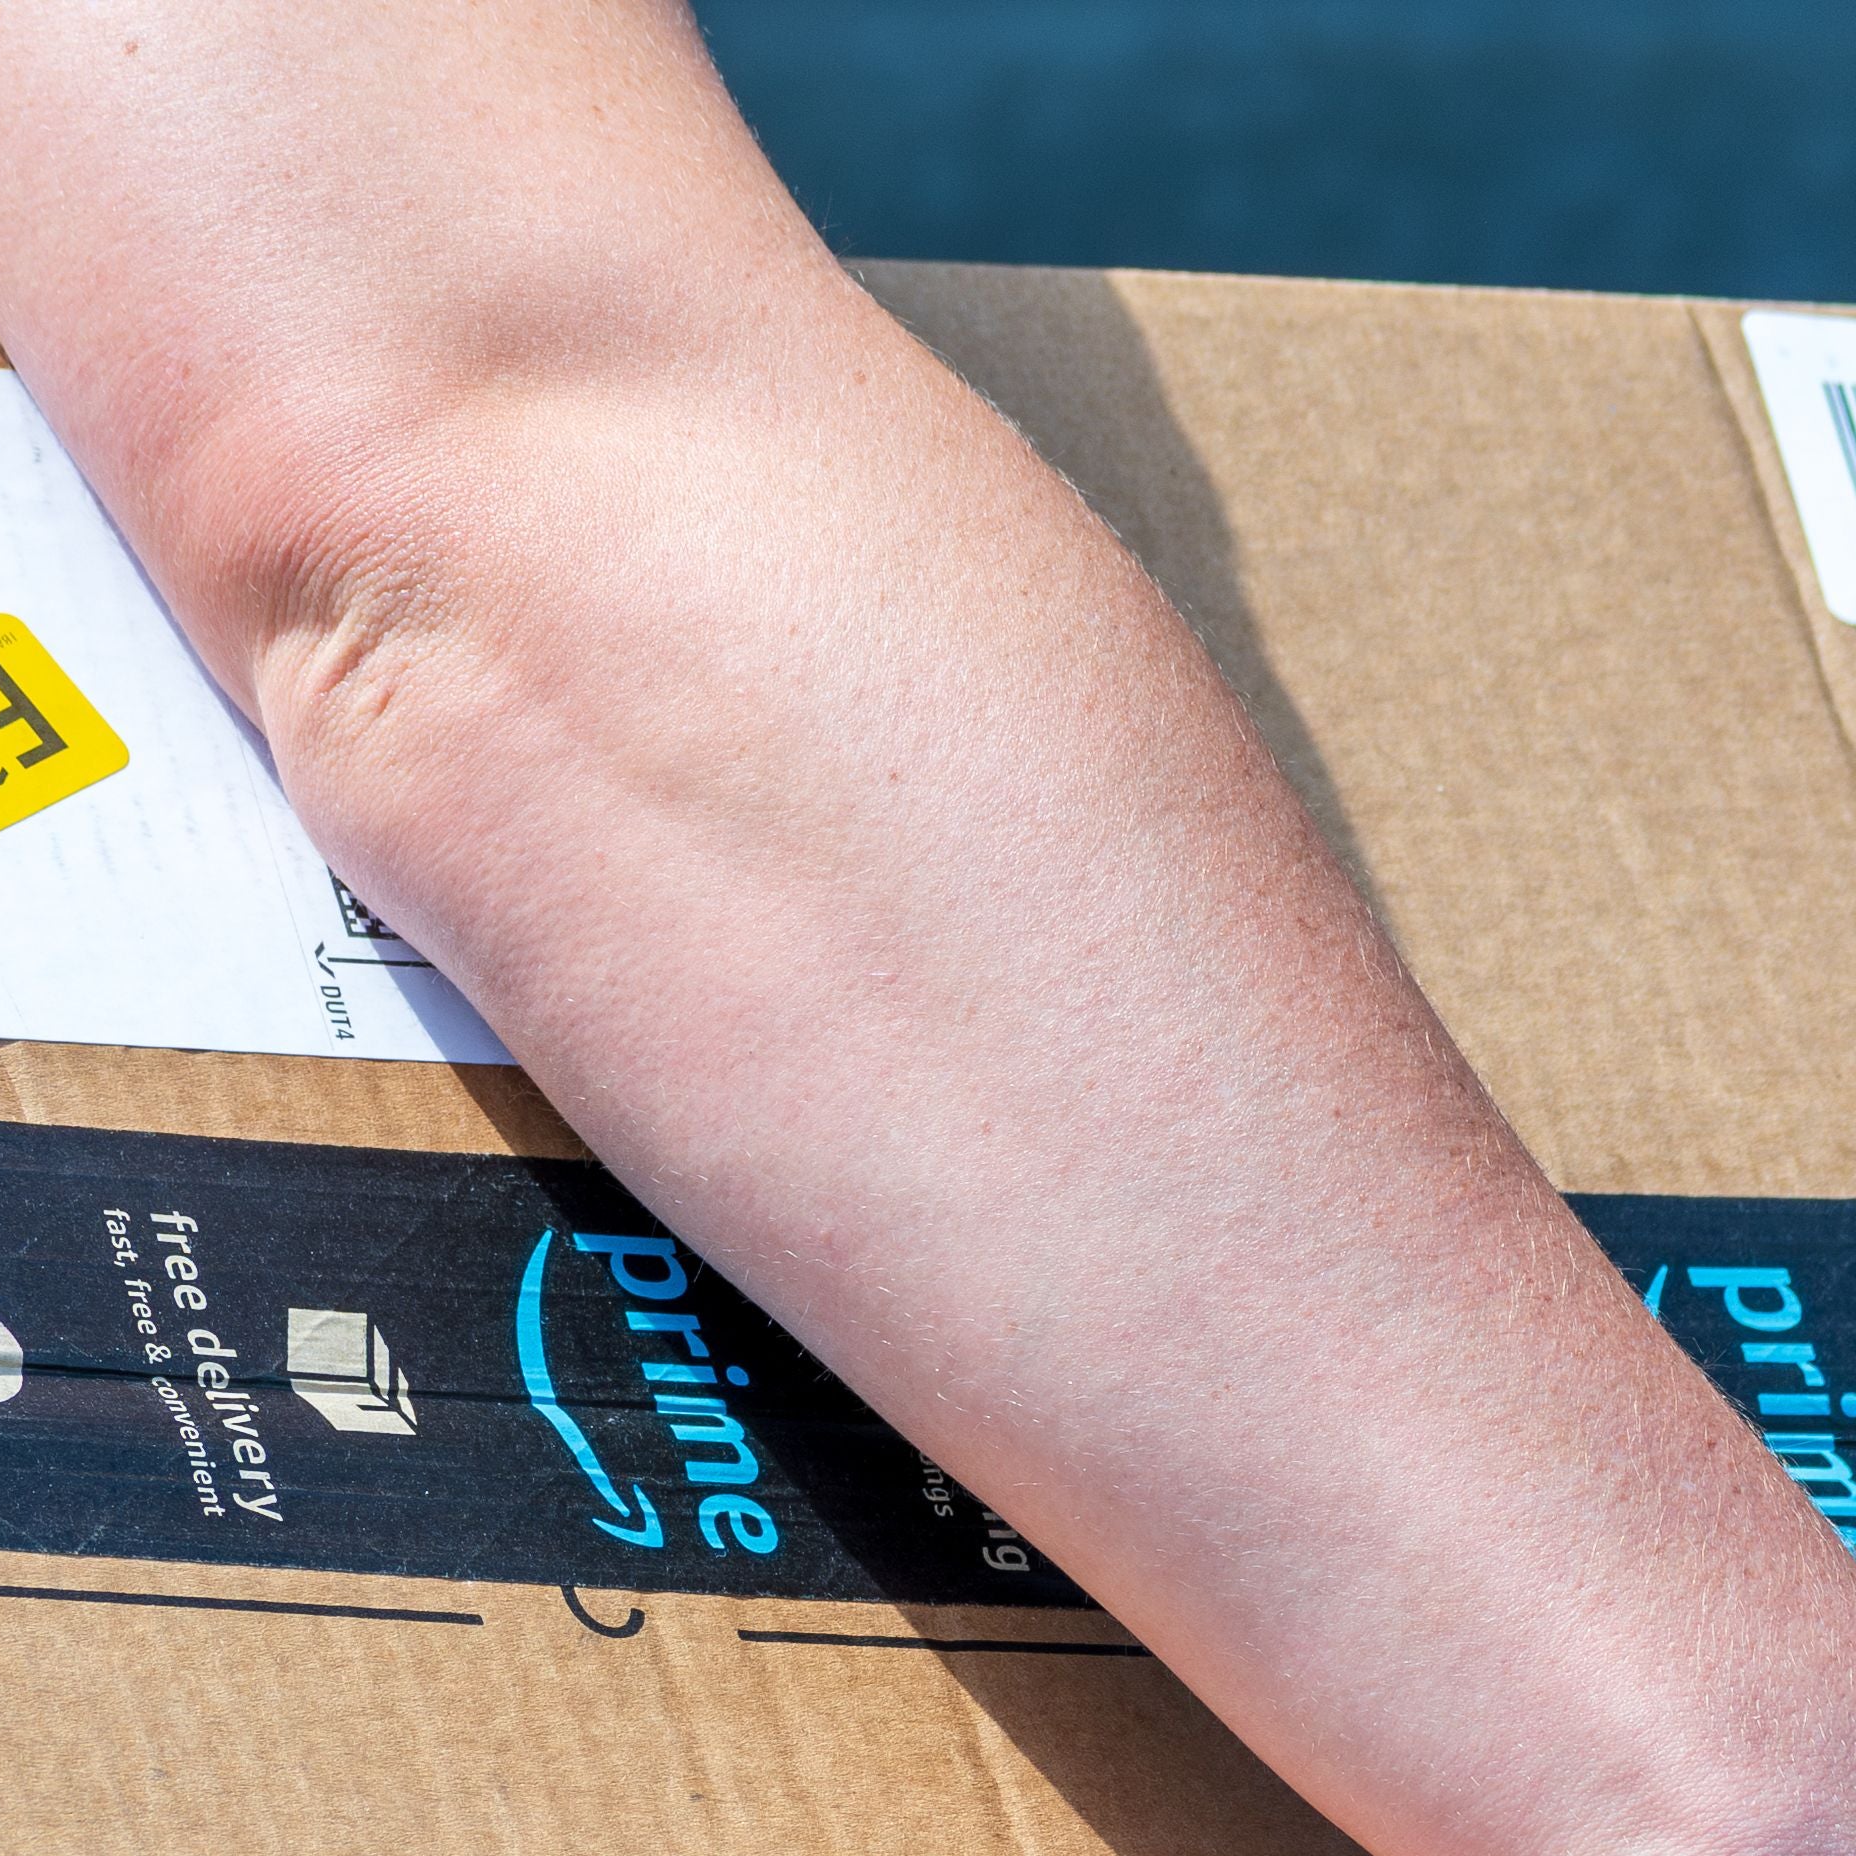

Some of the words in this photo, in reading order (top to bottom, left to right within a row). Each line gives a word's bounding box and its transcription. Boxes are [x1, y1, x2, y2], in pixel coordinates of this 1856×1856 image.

[320, 985, 355, 1040] DUT4
[103, 1208, 139, 1267] fast,
[125, 1279, 157, 1335] free
[145, 1342, 172, 1364] &
[150, 1210, 207, 1311] free
[187, 1329, 283, 1522] delivery
[573, 1232, 779, 1555] prime
[151, 1376, 226, 1518] convenient
